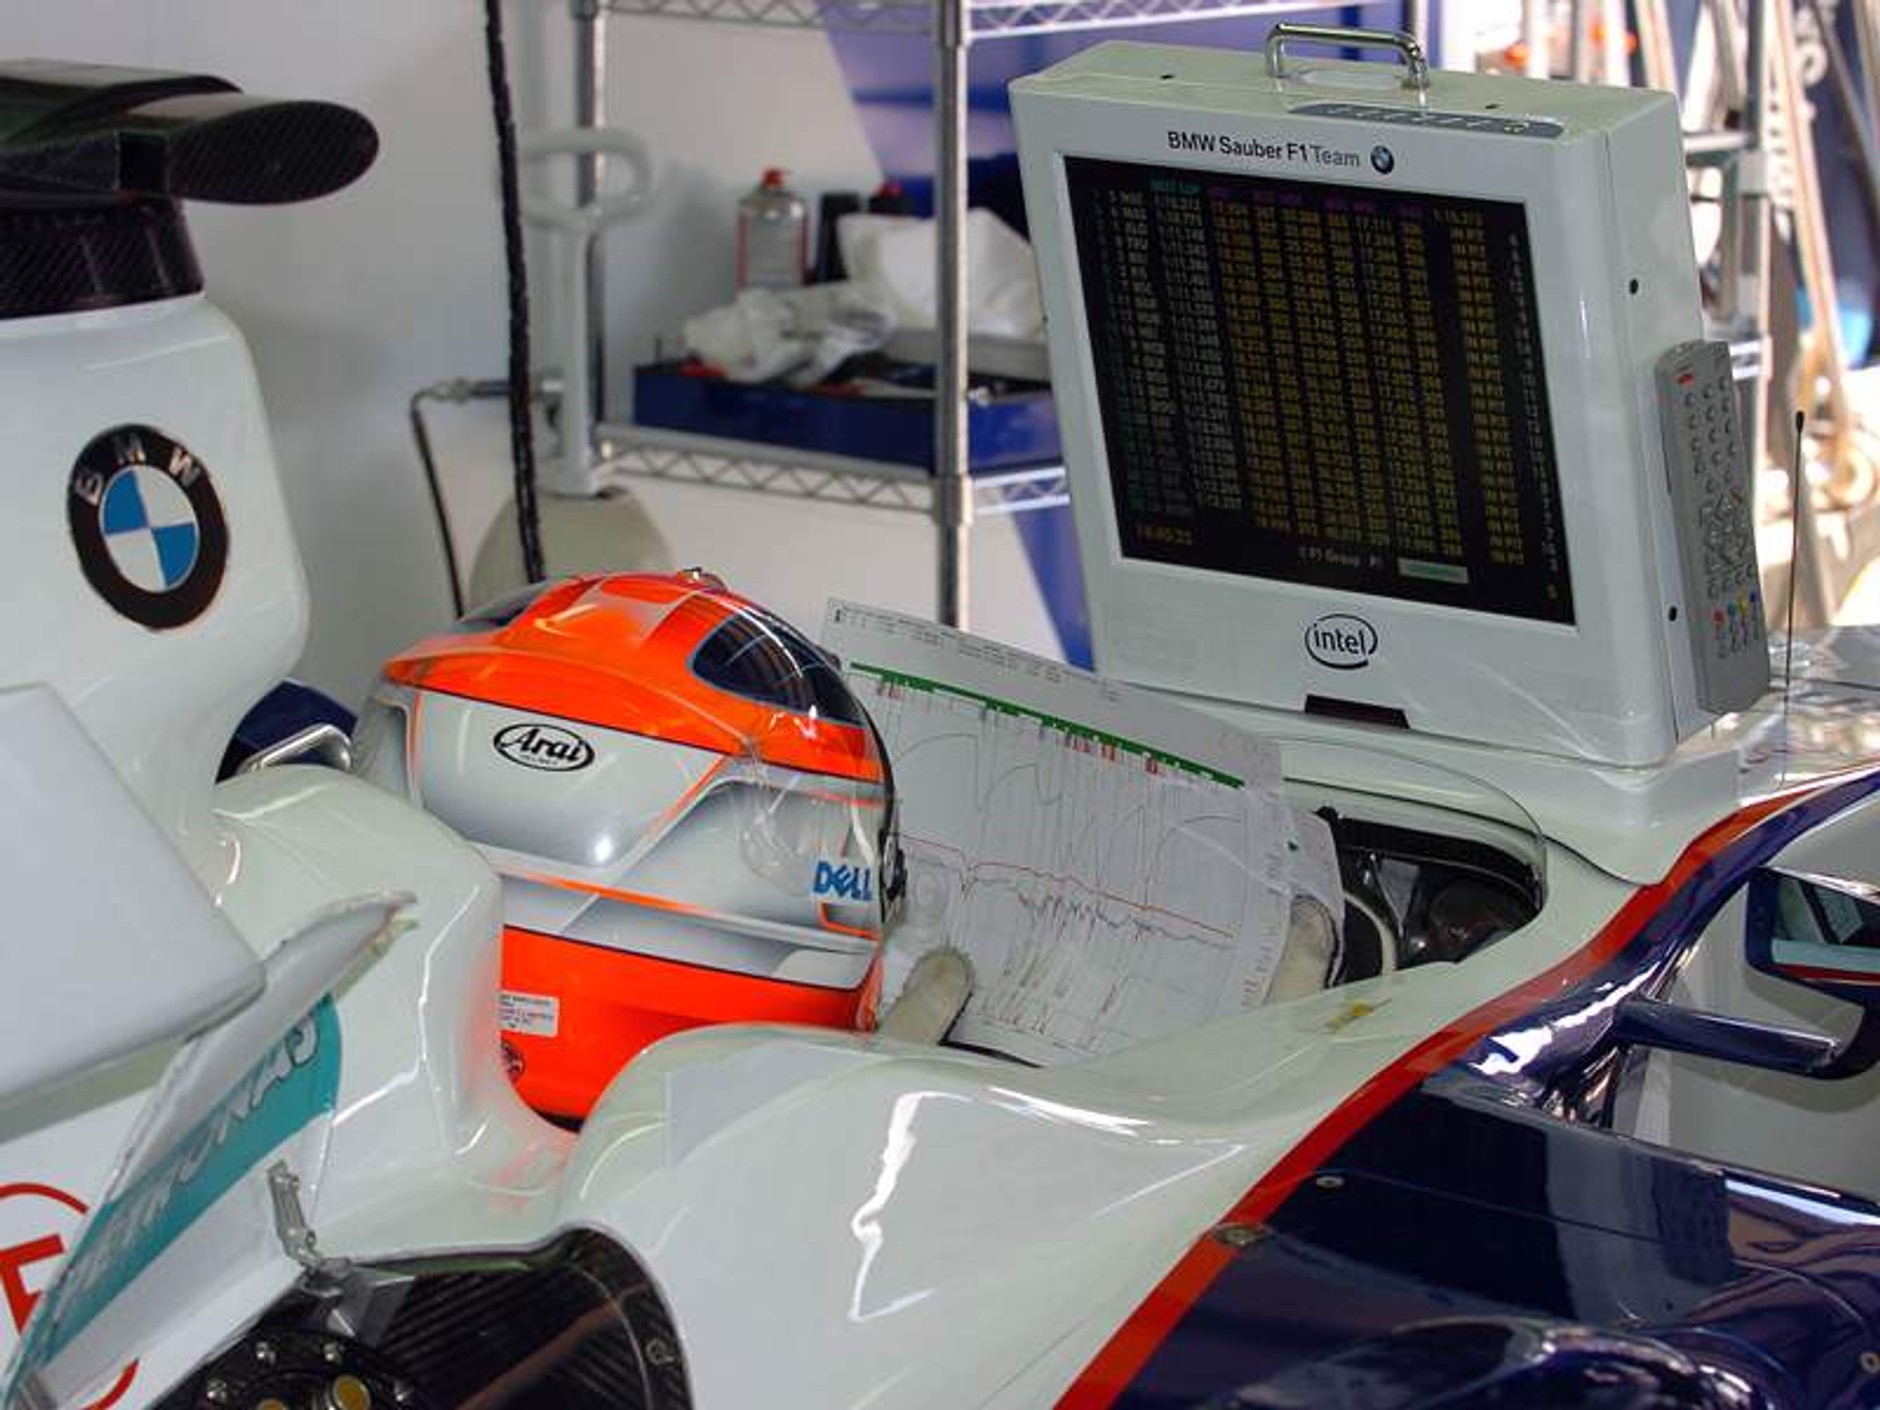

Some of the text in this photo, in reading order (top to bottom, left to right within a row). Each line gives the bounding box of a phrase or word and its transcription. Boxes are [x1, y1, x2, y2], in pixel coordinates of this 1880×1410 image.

[1167, 131, 1361, 168] BMW Sauber F1 Team
[75, 433, 200, 507] BMW
[1313, 622, 1367, 656] intel
[500, 728, 582, 761] Arai
[813, 860, 873, 902] DELL
